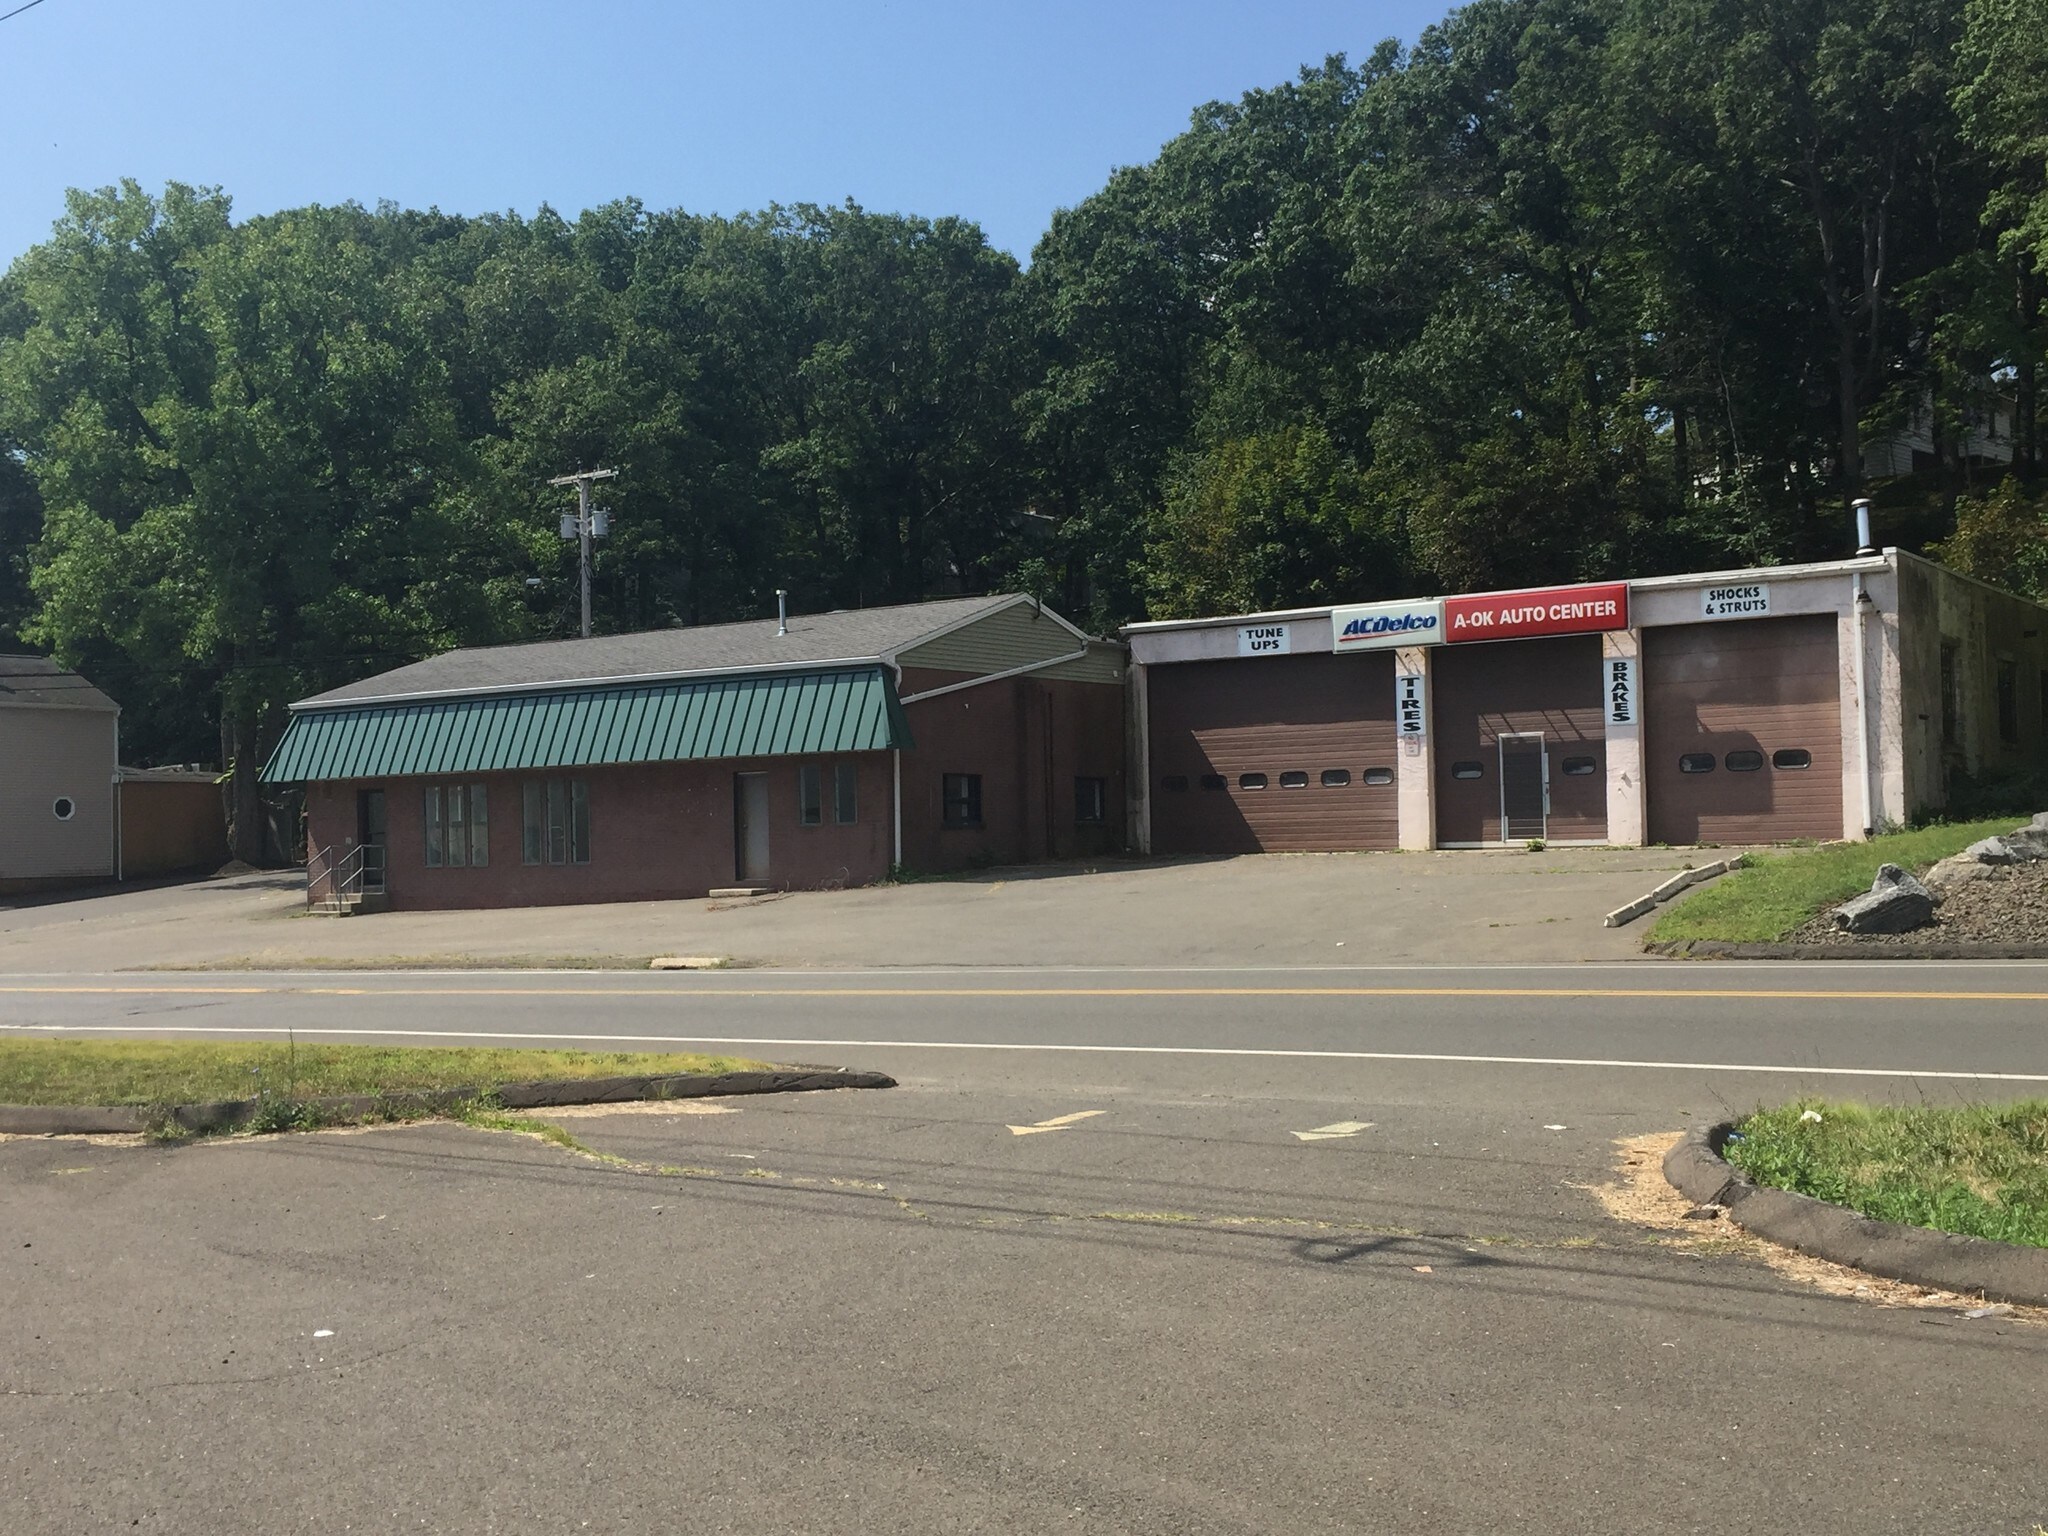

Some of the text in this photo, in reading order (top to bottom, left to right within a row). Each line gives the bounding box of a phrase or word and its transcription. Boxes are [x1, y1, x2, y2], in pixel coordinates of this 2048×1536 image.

[1709, 586, 1760, 601] SHOCKS
[1454, 600, 1617, 629] A-OK AUTO CENTER
[1705, 599, 1767, 615] & STRUTS
[1246, 627, 1284, 639] TUNE
[1342, 613, 1437, 636] ACDelco
[1251, 640, 1279, 651] UPS
[1611, 662, 1631, 722] BRAKES
[1401, 677, 1421, 732] TIRES
